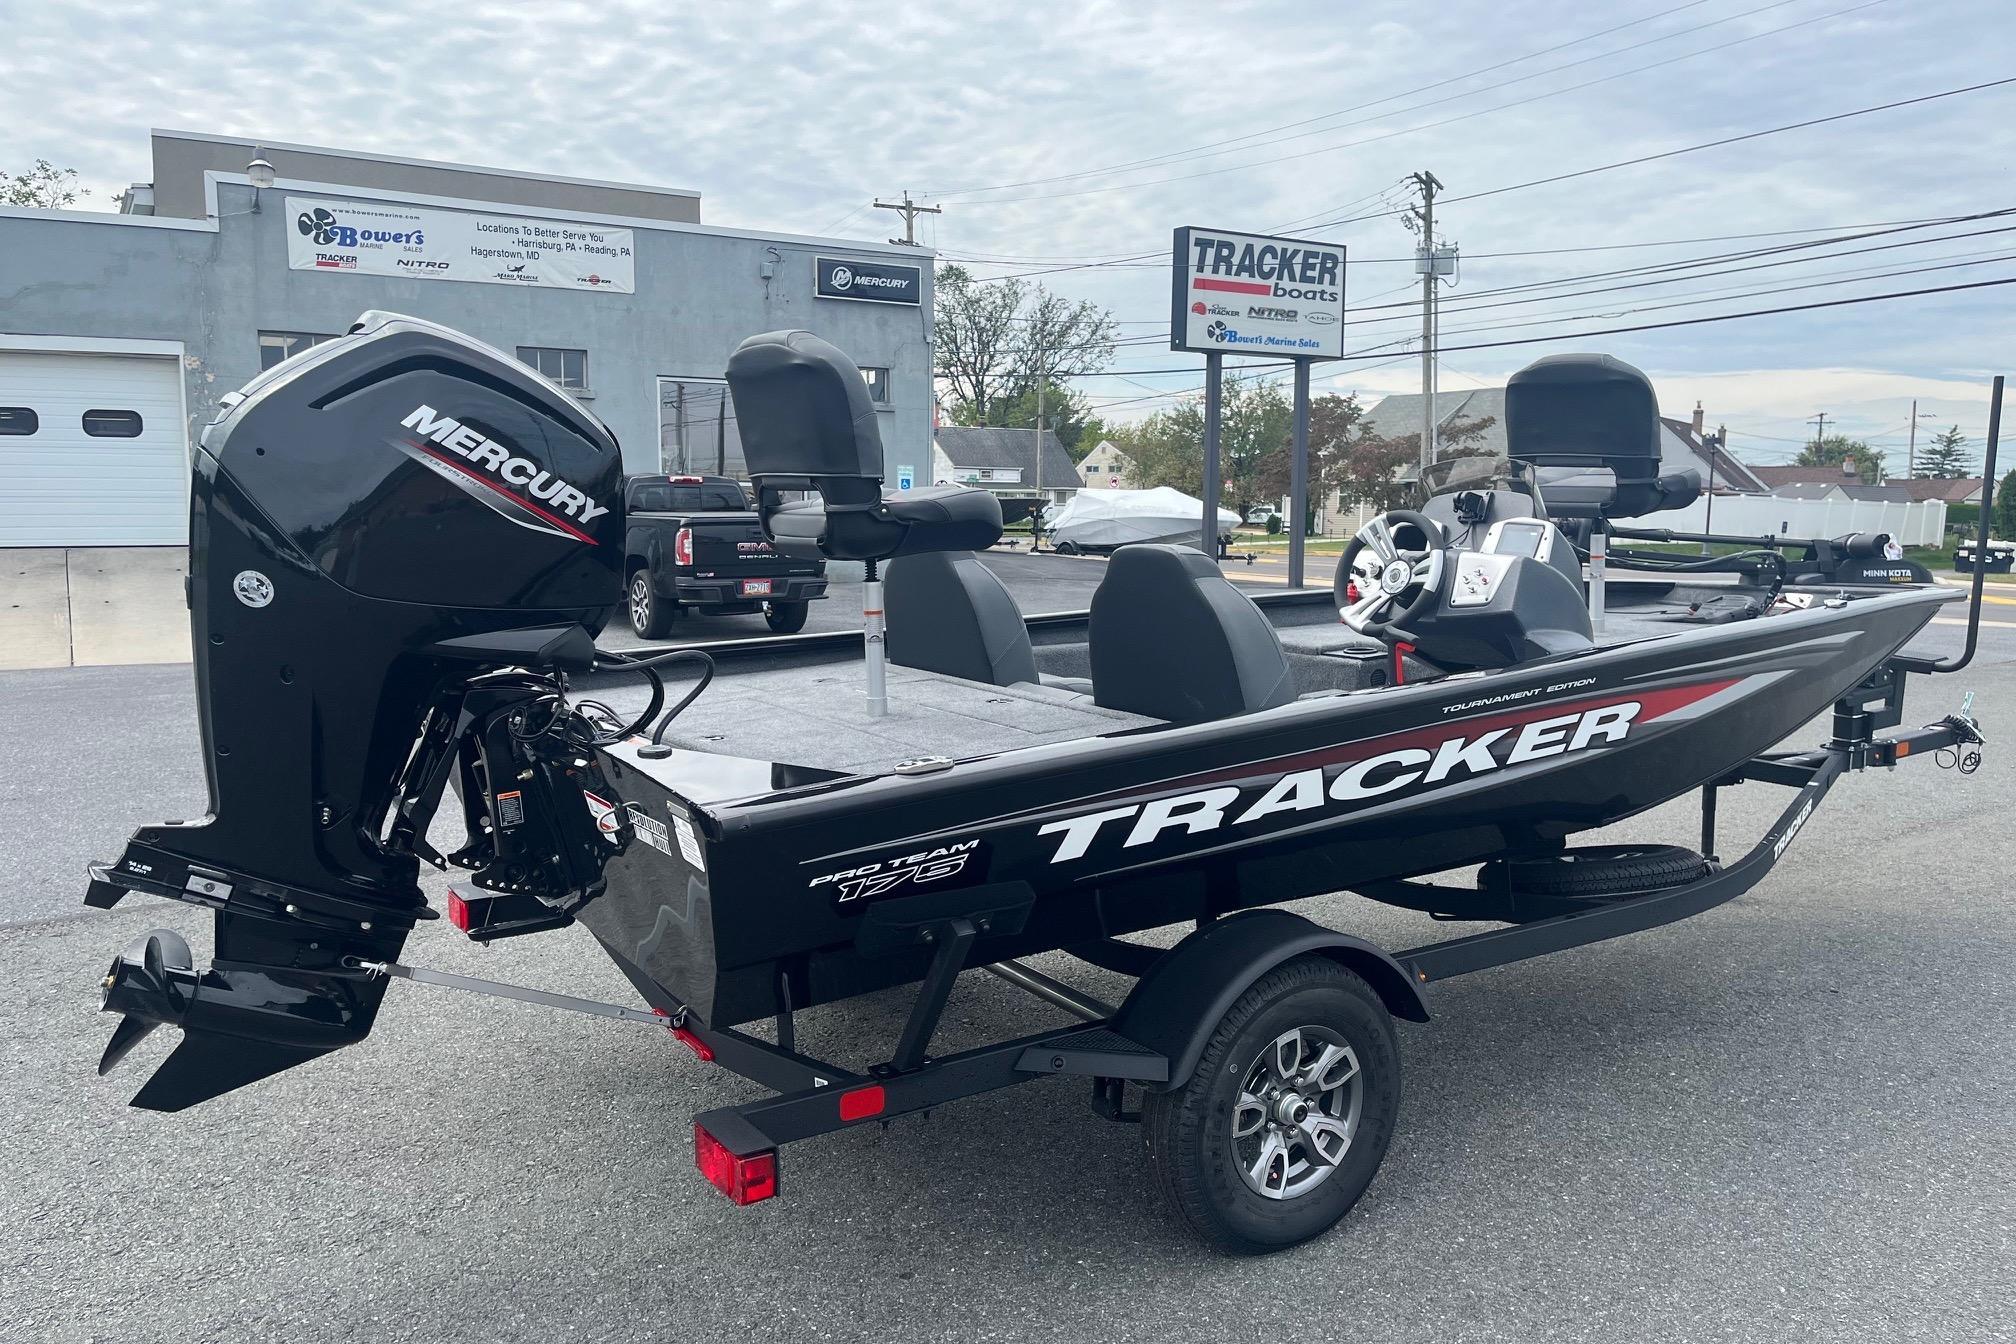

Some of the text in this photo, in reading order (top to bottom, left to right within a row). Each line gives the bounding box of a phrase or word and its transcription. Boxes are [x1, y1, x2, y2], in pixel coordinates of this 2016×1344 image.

[331, 208, 421, 220] www.bowersmarine.com
[476, 222, 604, 243] Locations To Better Serve You
[360, 242, 423, 254] MARINE SALES
[470, 246, 540, 260] Hagerstown, MD
[517, 238, 632, 258] Harrisburg, PA Reading, PA
[315, 253, 357, 263] TRACKER
[397, 259, 450, 269] NITRO
[1193, 237, 1339, 287] TRACKER
[854, 275, 910, 289] MERCURY
[1272, 282, 1339, 302] boats
[1207, 308, 1240, 316] TRACKER
[1247, 306, 1299, 319] NITRO
[1264, 336, 1297, 346] Marine
[1298, 338, 1320, 348] Sales
[400, 404, 610, 524] MERCURY
[738, 542, 773, 551] GM
[1863, 569, 1912, 577] MINN KOTA
[1442, 677, 1597, 714] TOURNAMENT EDITION
[1037, 700, 1642, 865] TRACKER
[1773, 797, 1813, 861] TRACKER
[808, 838, 980, 888] PRO TEAM
[837, 853, 970, 903] 175
